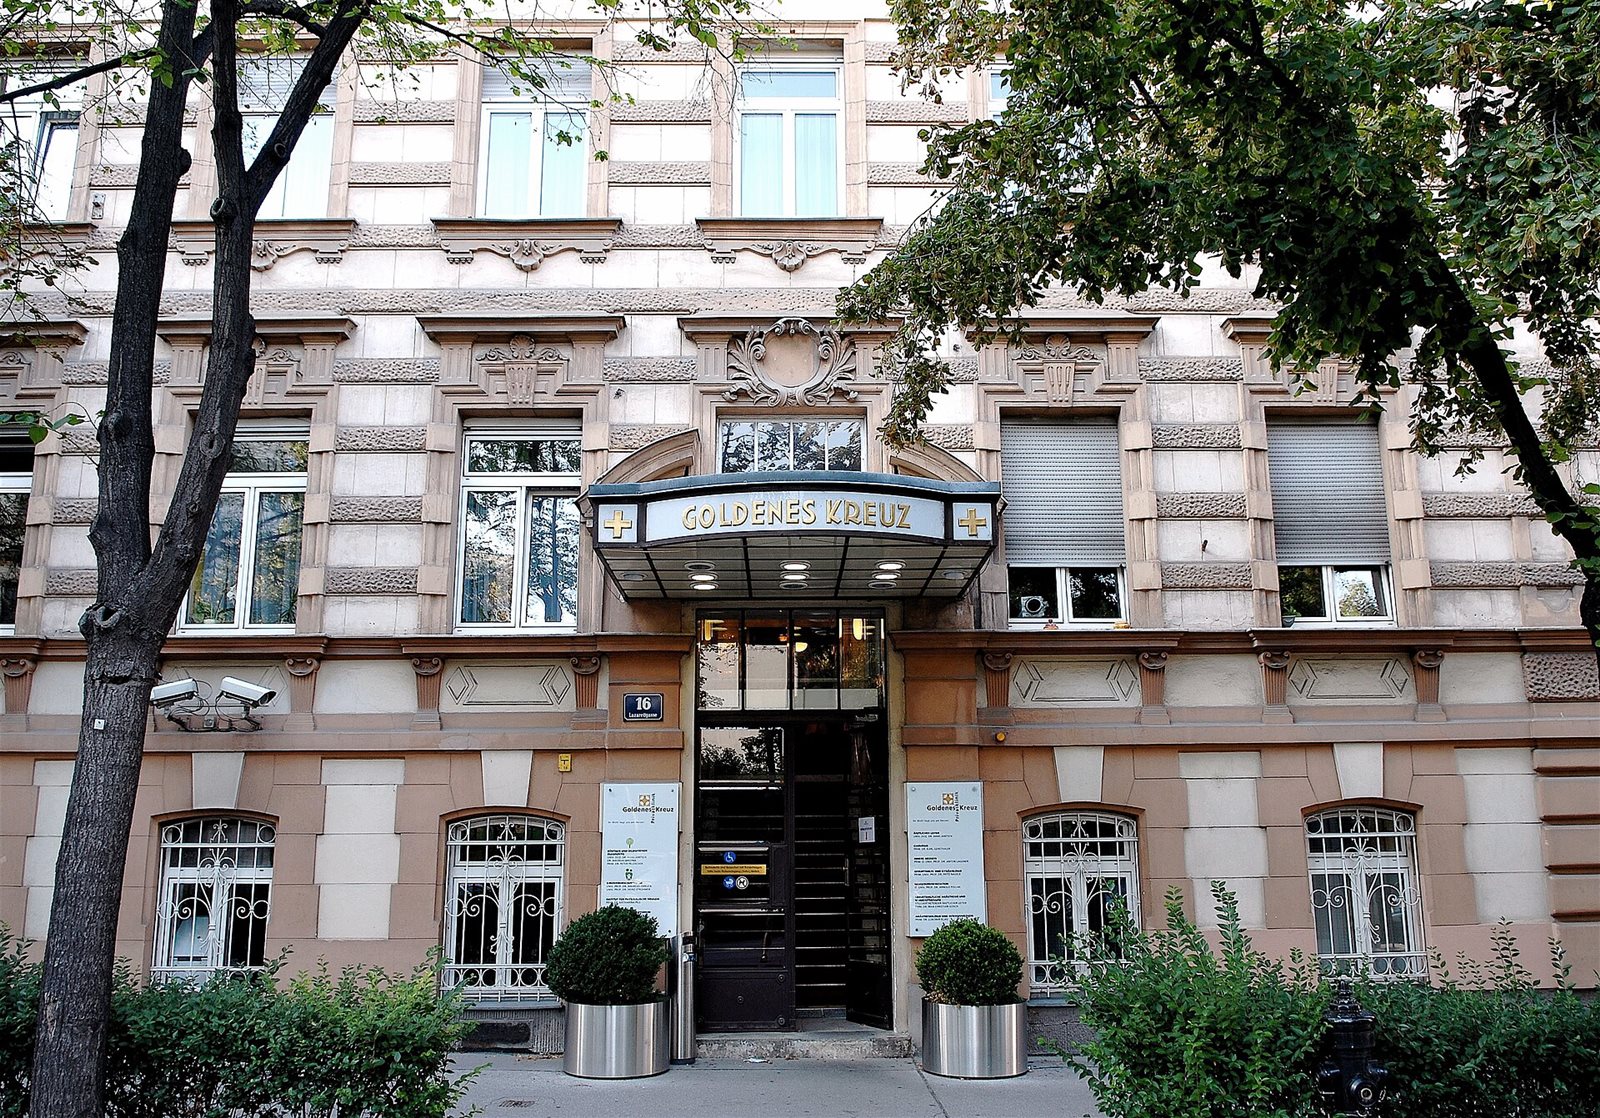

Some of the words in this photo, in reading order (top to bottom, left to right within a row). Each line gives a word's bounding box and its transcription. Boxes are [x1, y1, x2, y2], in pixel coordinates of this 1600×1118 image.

[682, 499, 816, 530] GOLDENES
[826, 499, 911, 529] KREUZ
[635, 696, 652, 711] 16
